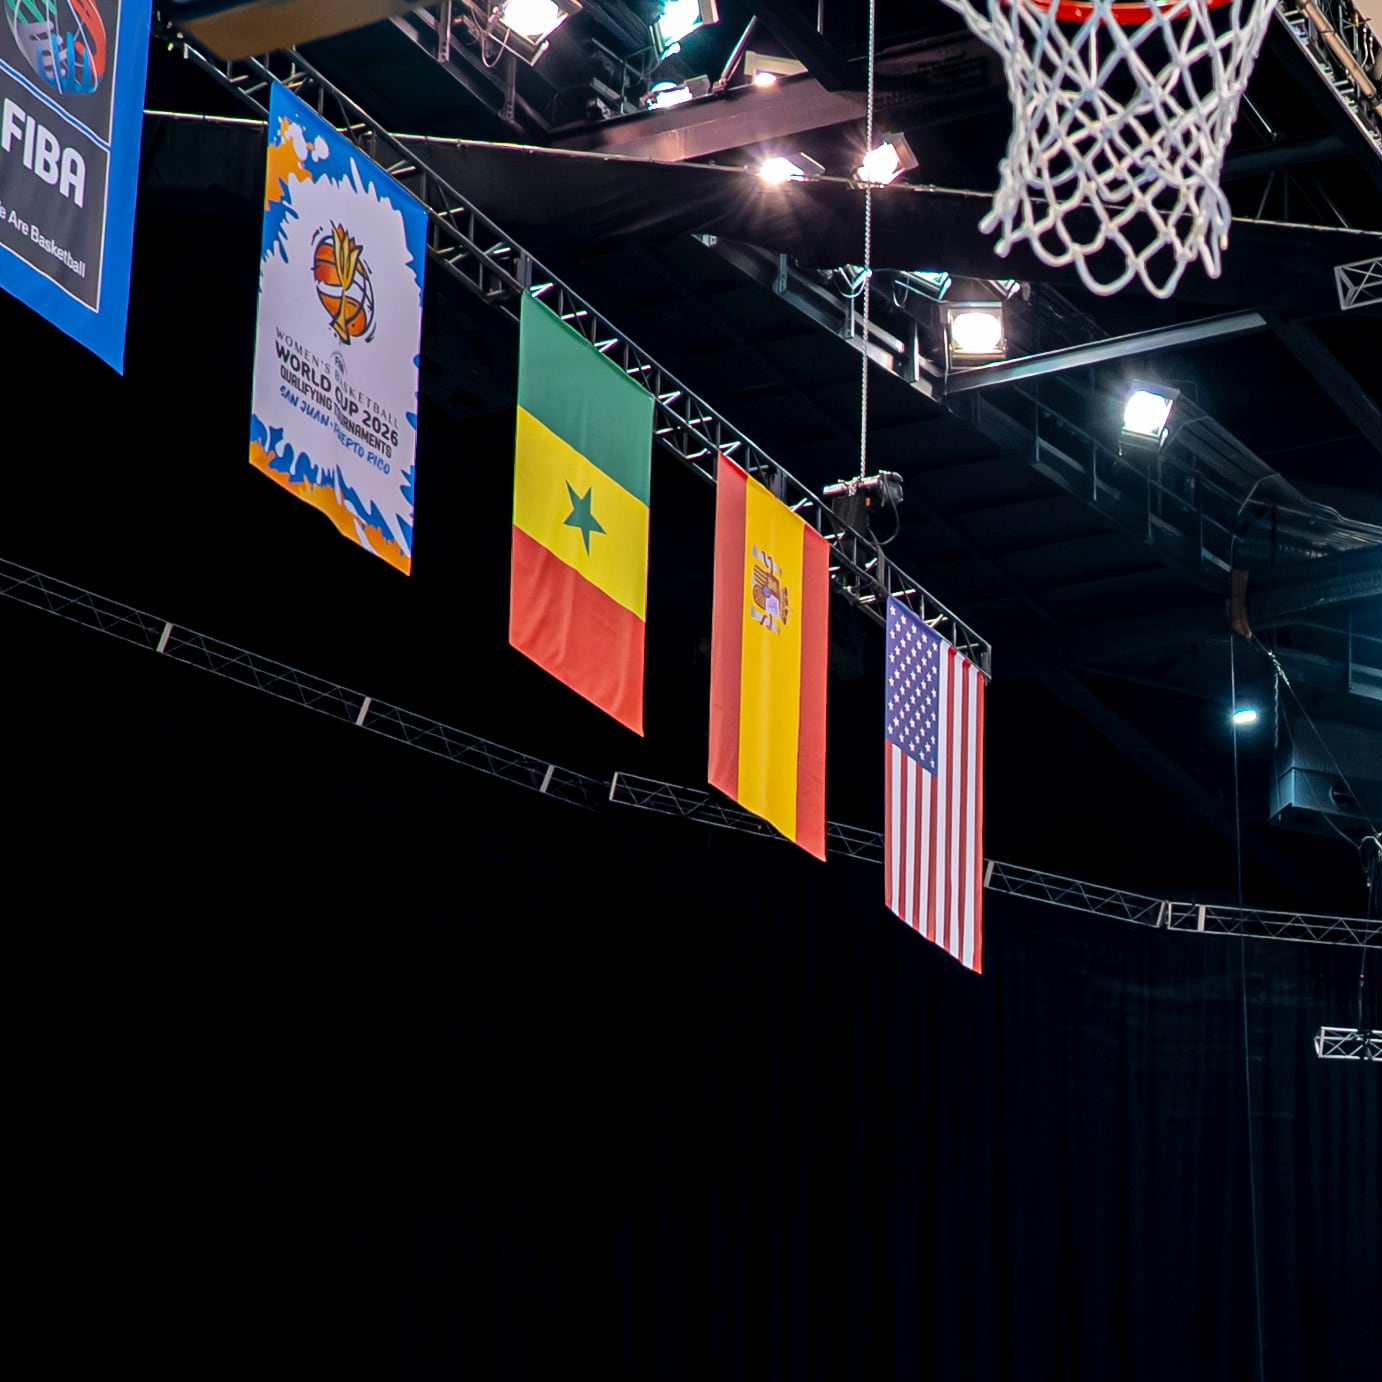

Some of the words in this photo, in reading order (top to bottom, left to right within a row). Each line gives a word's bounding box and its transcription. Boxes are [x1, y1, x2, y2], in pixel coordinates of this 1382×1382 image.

[1, 97, 86, 208] FIBA
[8, 210, 29, 236] Are
[30, 227, 86, 278] Basketball
[275, 339, 332, 393] WORLD
[334, 385, 359, 417] CUP
[362, 410, 399, 447] 2026
[276, 326, 331, 374] WOMEN'S
[334, 369, 399, 430] BASKETBALL
[280, 364, 333, 412] QUALIFYING
[333, 401, 392, 459] TOURNAMENTS
[279, 385, 298, 404] SAN
[366, 451, 391, 475] RICO
